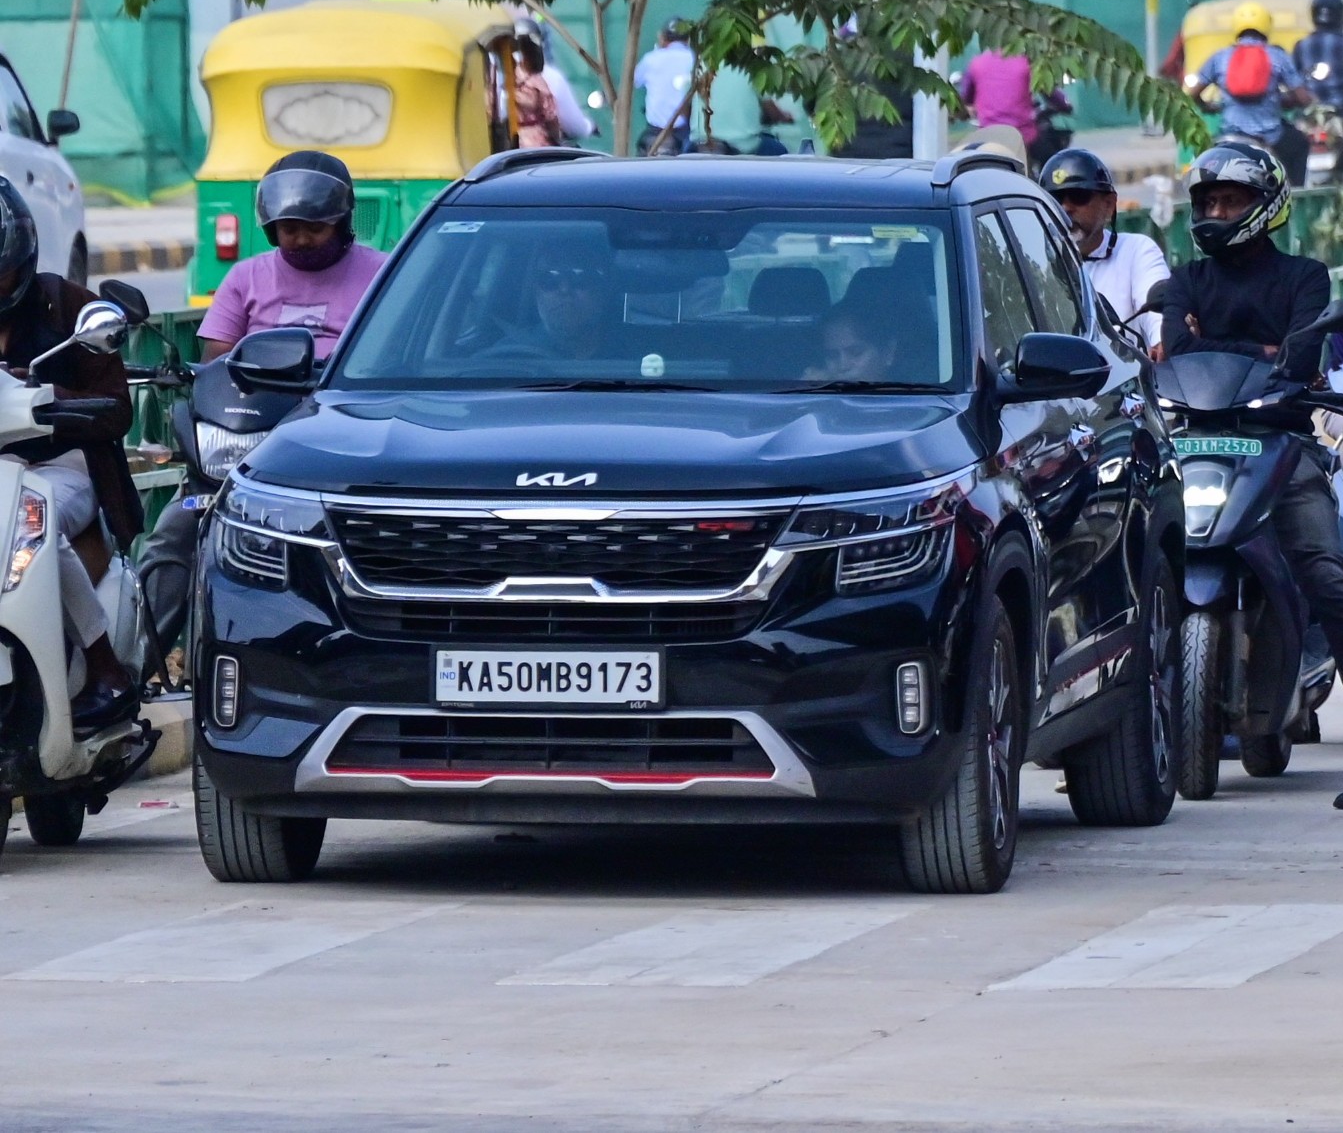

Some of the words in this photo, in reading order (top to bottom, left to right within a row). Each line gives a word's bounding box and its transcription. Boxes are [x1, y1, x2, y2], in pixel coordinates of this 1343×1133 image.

[224, 407, 261, 416] HONDA
[439, 671, 456, 680] IND
[457, 660, 653, 693] KA50MB9173
